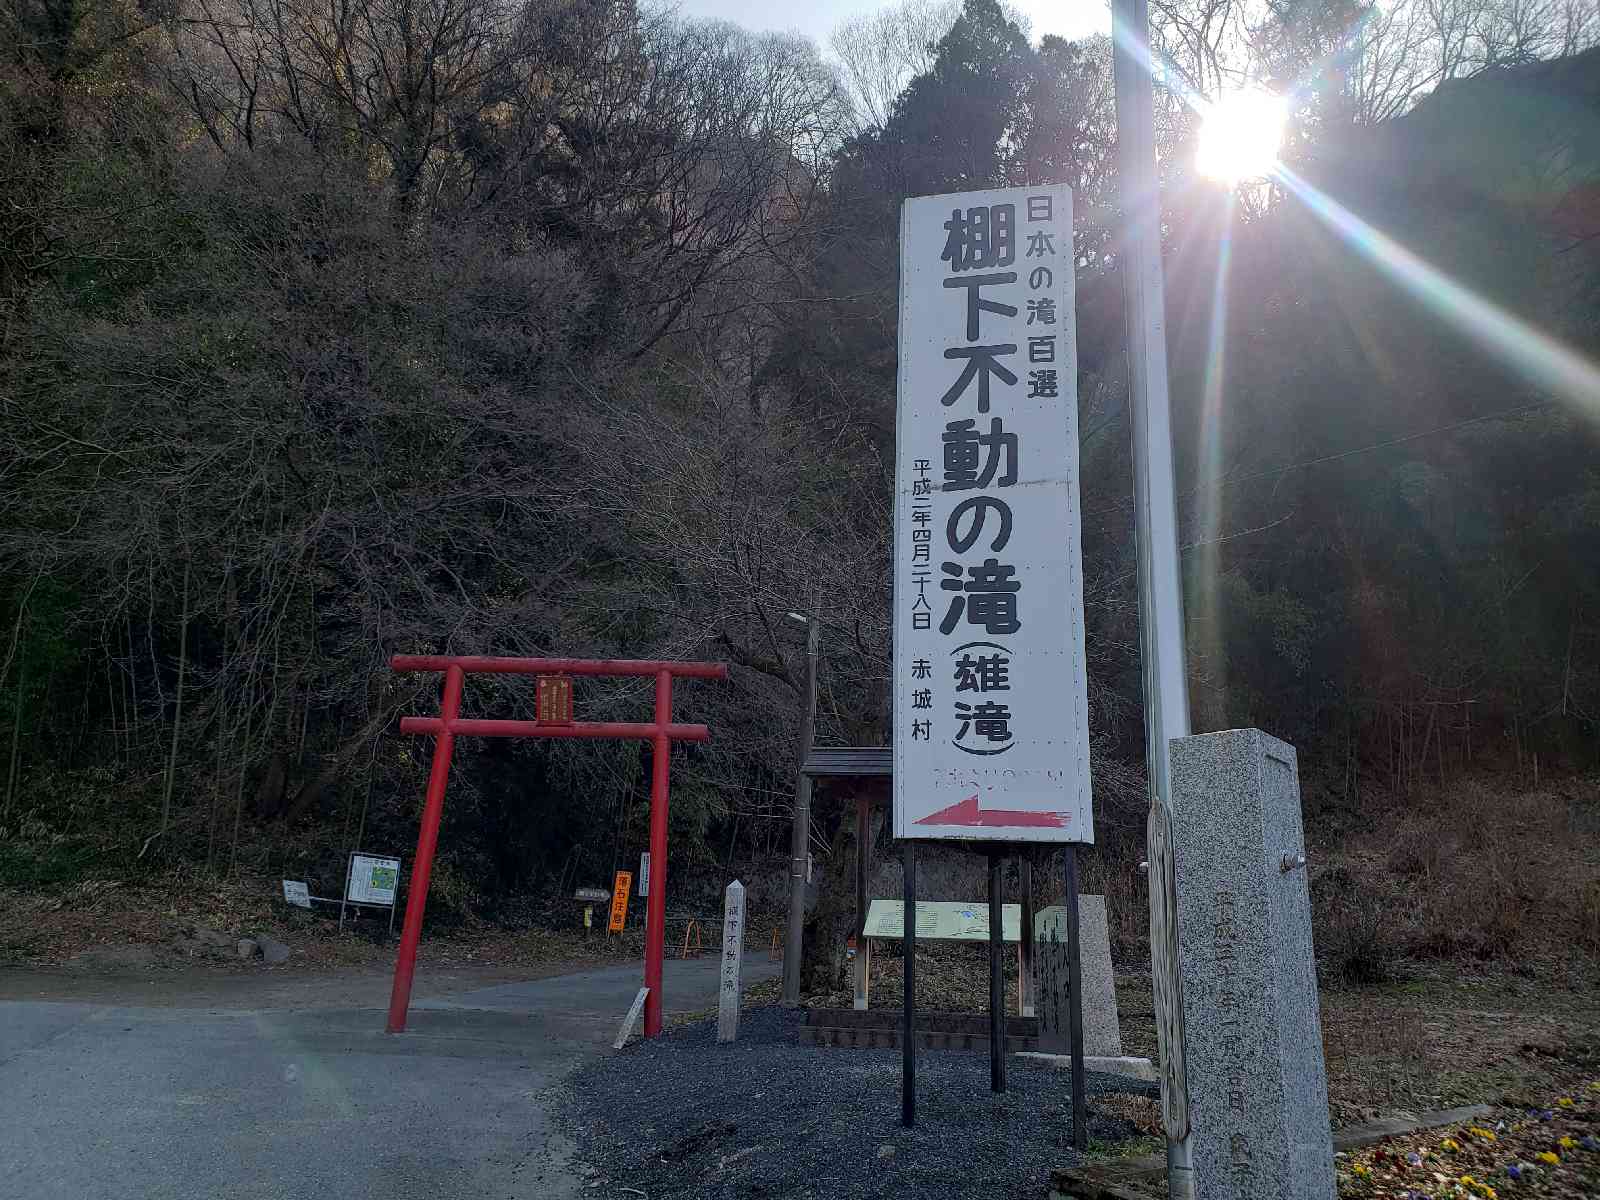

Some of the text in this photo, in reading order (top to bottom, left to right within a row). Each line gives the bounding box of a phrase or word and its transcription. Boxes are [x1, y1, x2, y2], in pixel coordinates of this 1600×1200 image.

[1025, 195, 1059, 399] 日本の滝百選
[911, 459, 933, 741] 平成二年四月二十八日 赤城村
